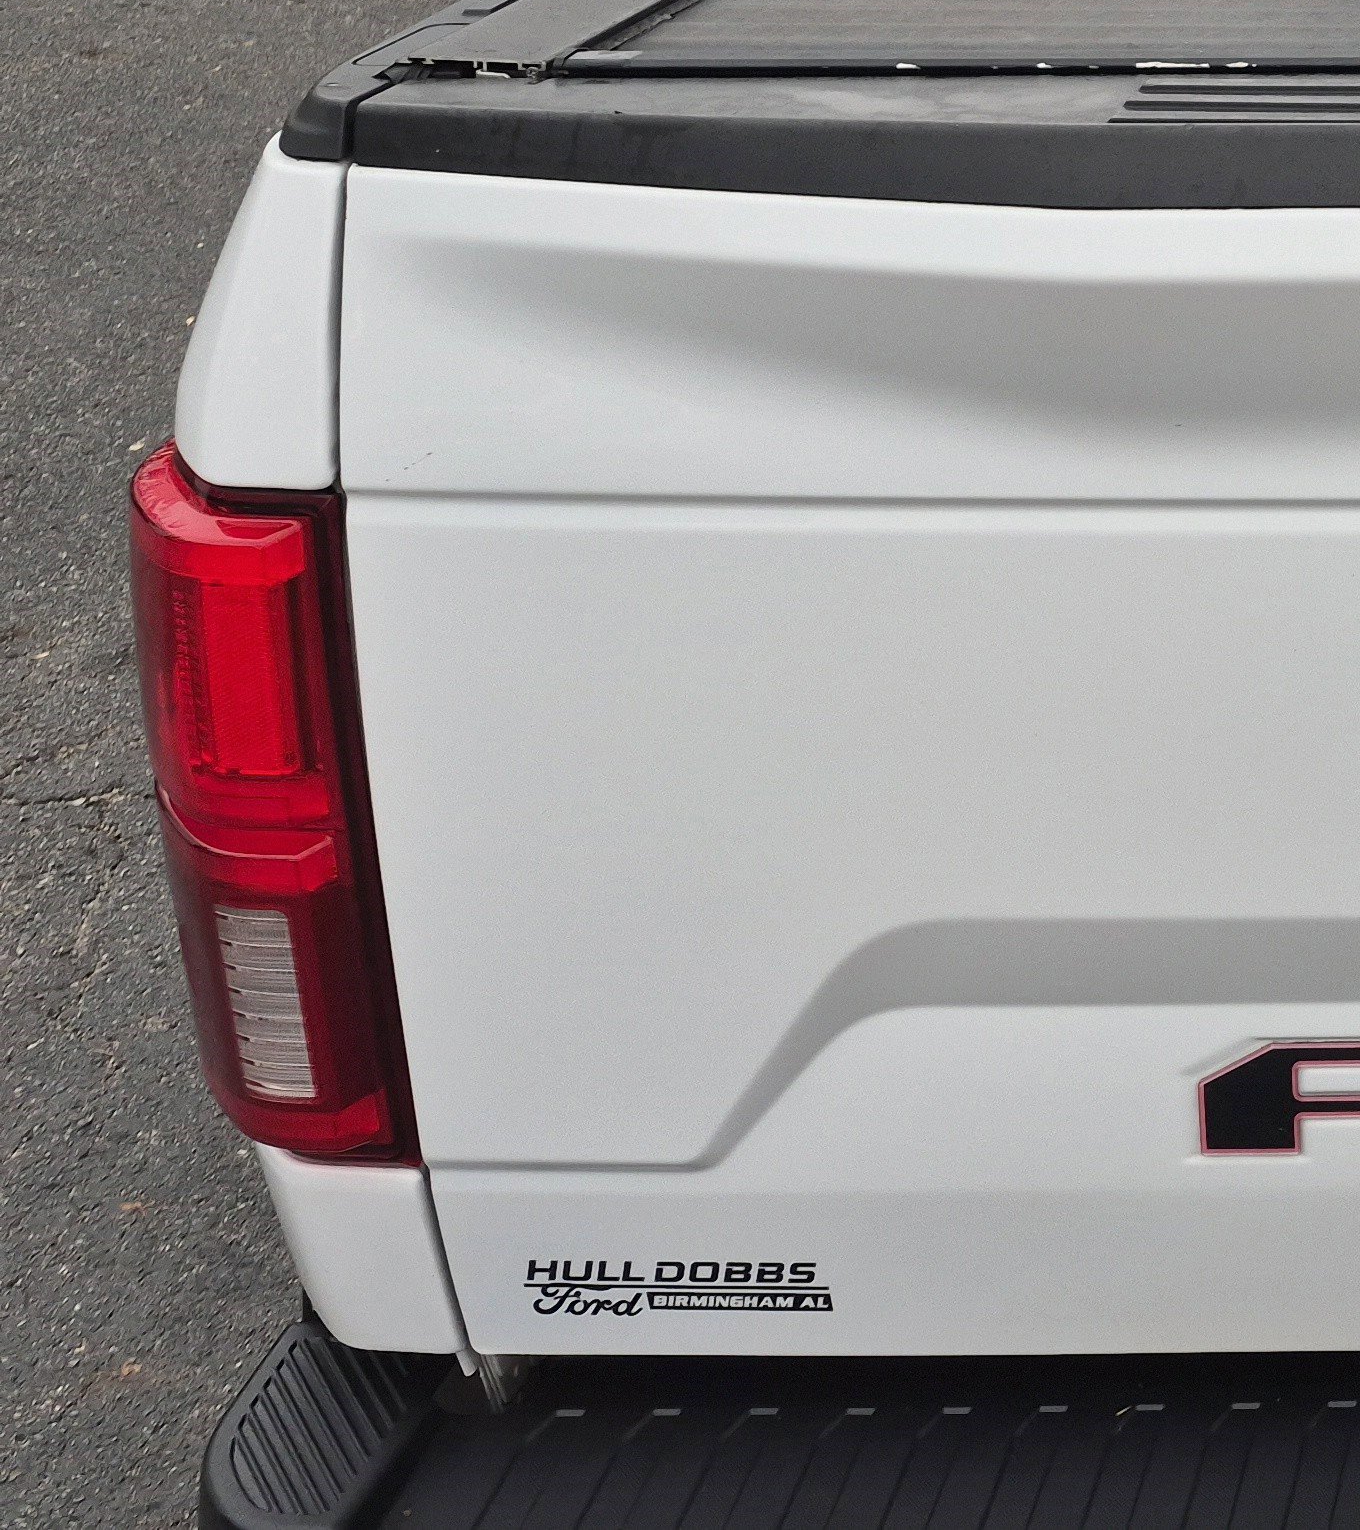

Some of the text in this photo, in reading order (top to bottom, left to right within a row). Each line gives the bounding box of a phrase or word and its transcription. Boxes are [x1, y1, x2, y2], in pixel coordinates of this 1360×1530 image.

[526, 1259, 817, 1284] HULL DOBBS
[532, 1283, 830, 1317] Ford BIRMINGHAM AL
